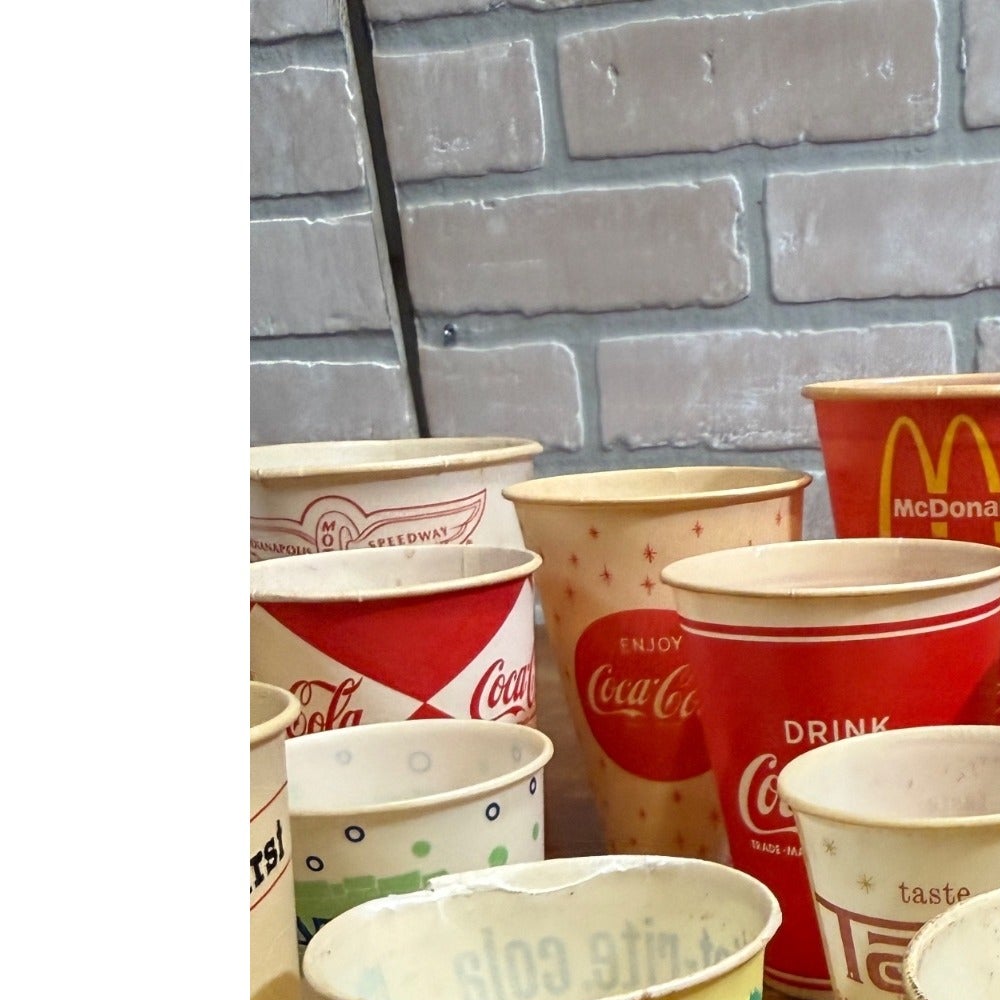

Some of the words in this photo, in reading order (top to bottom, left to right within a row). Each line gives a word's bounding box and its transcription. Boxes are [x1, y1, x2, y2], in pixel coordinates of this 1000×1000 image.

[368, 527, 447, 548] SPEEDWAY
[620, 636, 682, 652] ENJOY
[286, 677, 363, 738] Cola
[470, 658, 537, 720] Coca
[588, 664, 701, 719] Coca-Co
[784, 716, 890, 744] DRINK
[899, 881, 971, 905] taste
[815, 892, 926, 995] Ta
